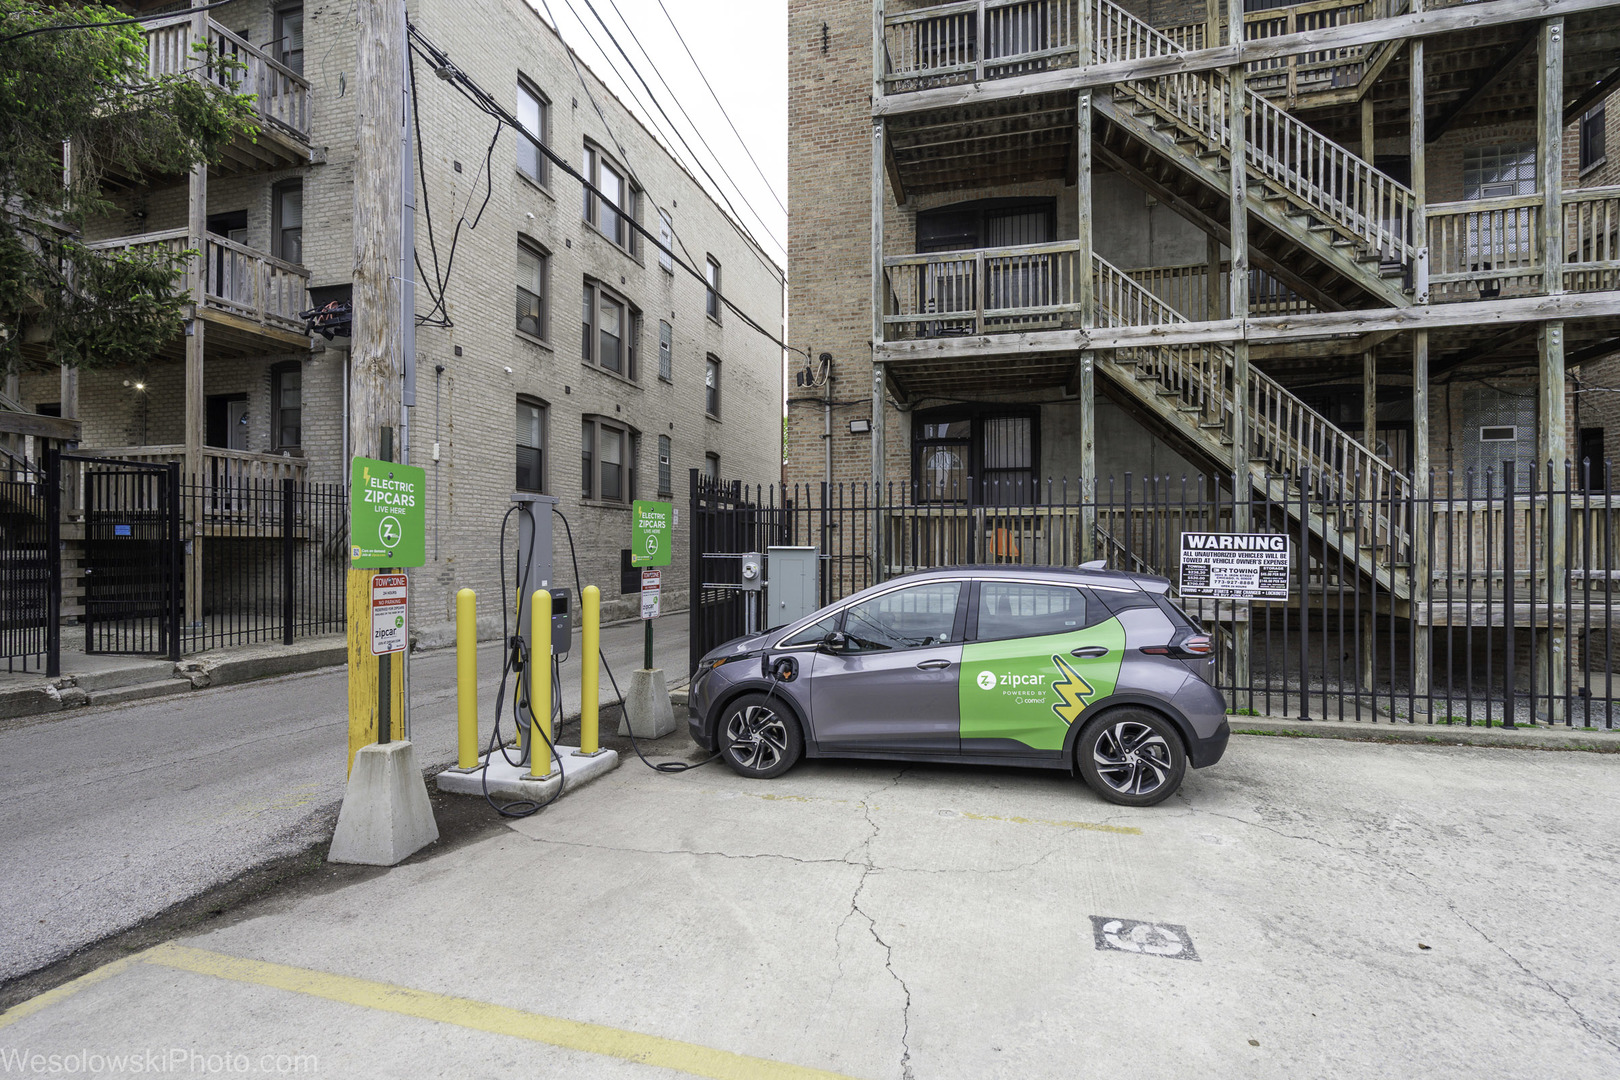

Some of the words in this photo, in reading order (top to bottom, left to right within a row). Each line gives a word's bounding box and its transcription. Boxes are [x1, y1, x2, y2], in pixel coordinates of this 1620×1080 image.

[371, 477, 414, 493] ELECTRIC
[364, 489, 416, 507] ZIPCARS
[374, 505, 388, 513] LIVE
[390, 506, 406, 515] HERE
[642, 512, 666, 520] ELECTRIC
[638, 520, 666, 528] ZIPCARS
[1188, 535, 1284, 550] WARNING
[375, 578, 388, 586] TOW
[375, 628, 396, 639] zipcar
